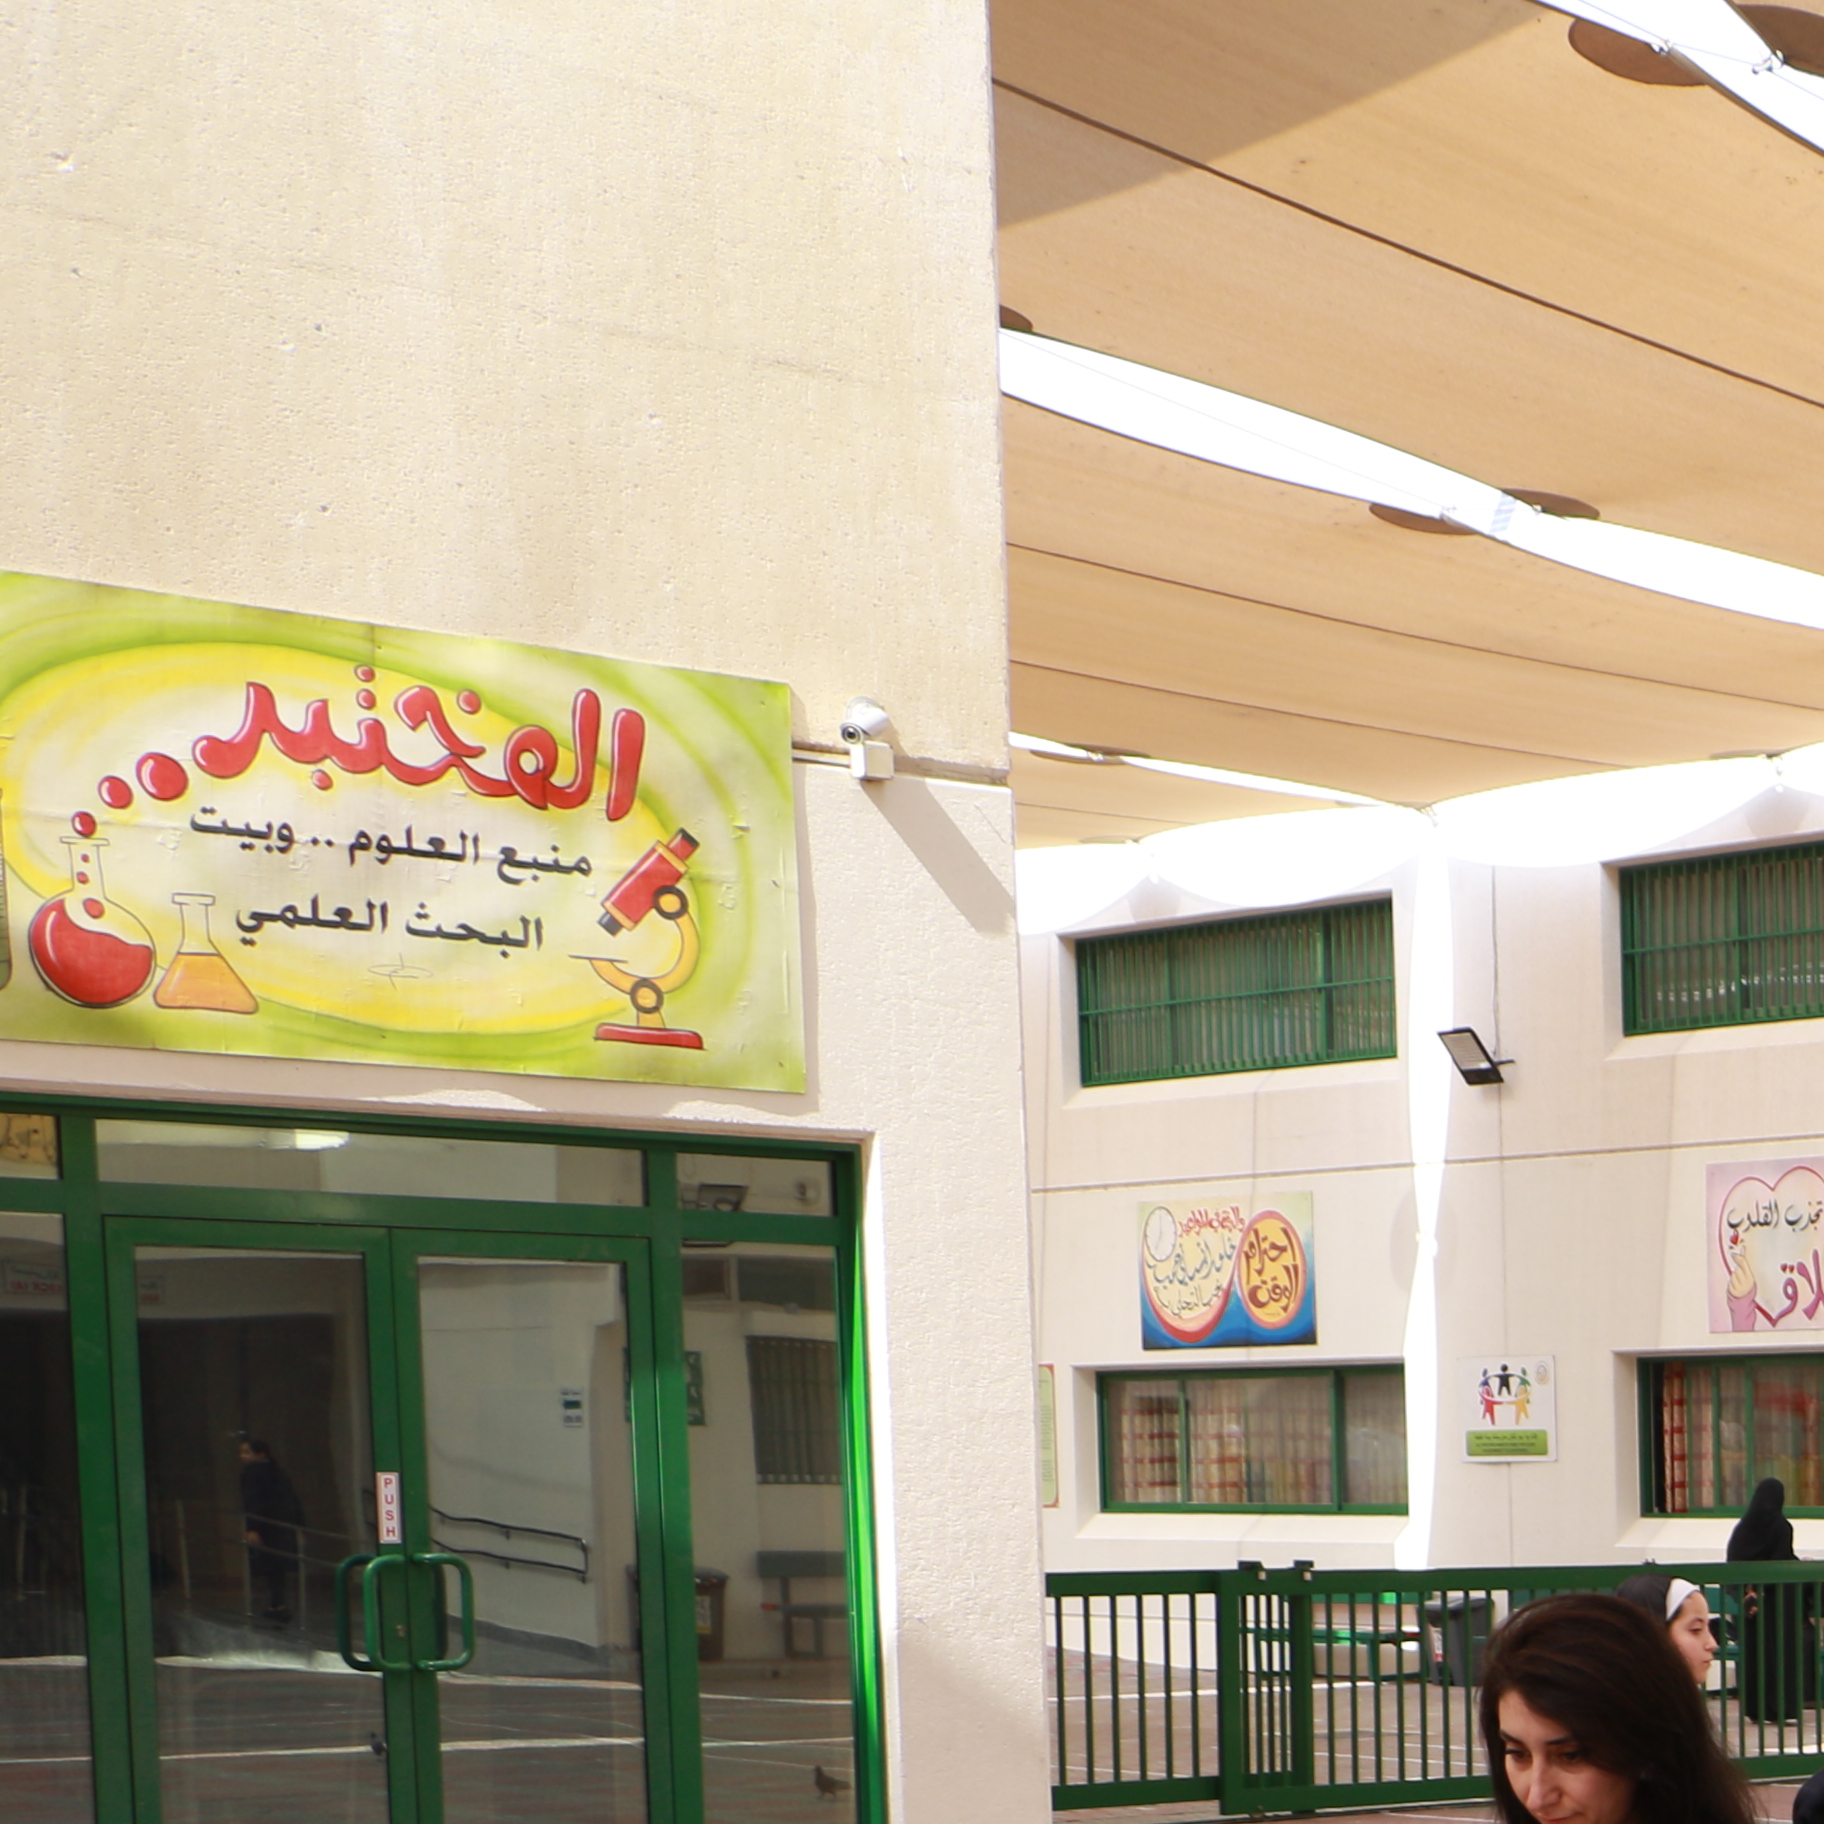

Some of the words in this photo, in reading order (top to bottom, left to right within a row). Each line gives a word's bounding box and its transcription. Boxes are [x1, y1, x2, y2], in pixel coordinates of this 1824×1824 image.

[189, 803, 295, 852] وبيت
[348, 825, 481, 865] العلوم
[496, 839, 593, 884] منبع
[235, 894, 389, 947] العلمي
[405, 902, 545, 959] البحث
[1726, 1199, 1780, 1238] القلوب
[1784, 1200, 1824, 1233] تجذب
[1242, 1226, 1297, 1285] احترام
[1247, 1263, 1300, 1314] الوقت
[383, 1477, 396, 1537] PUSH
